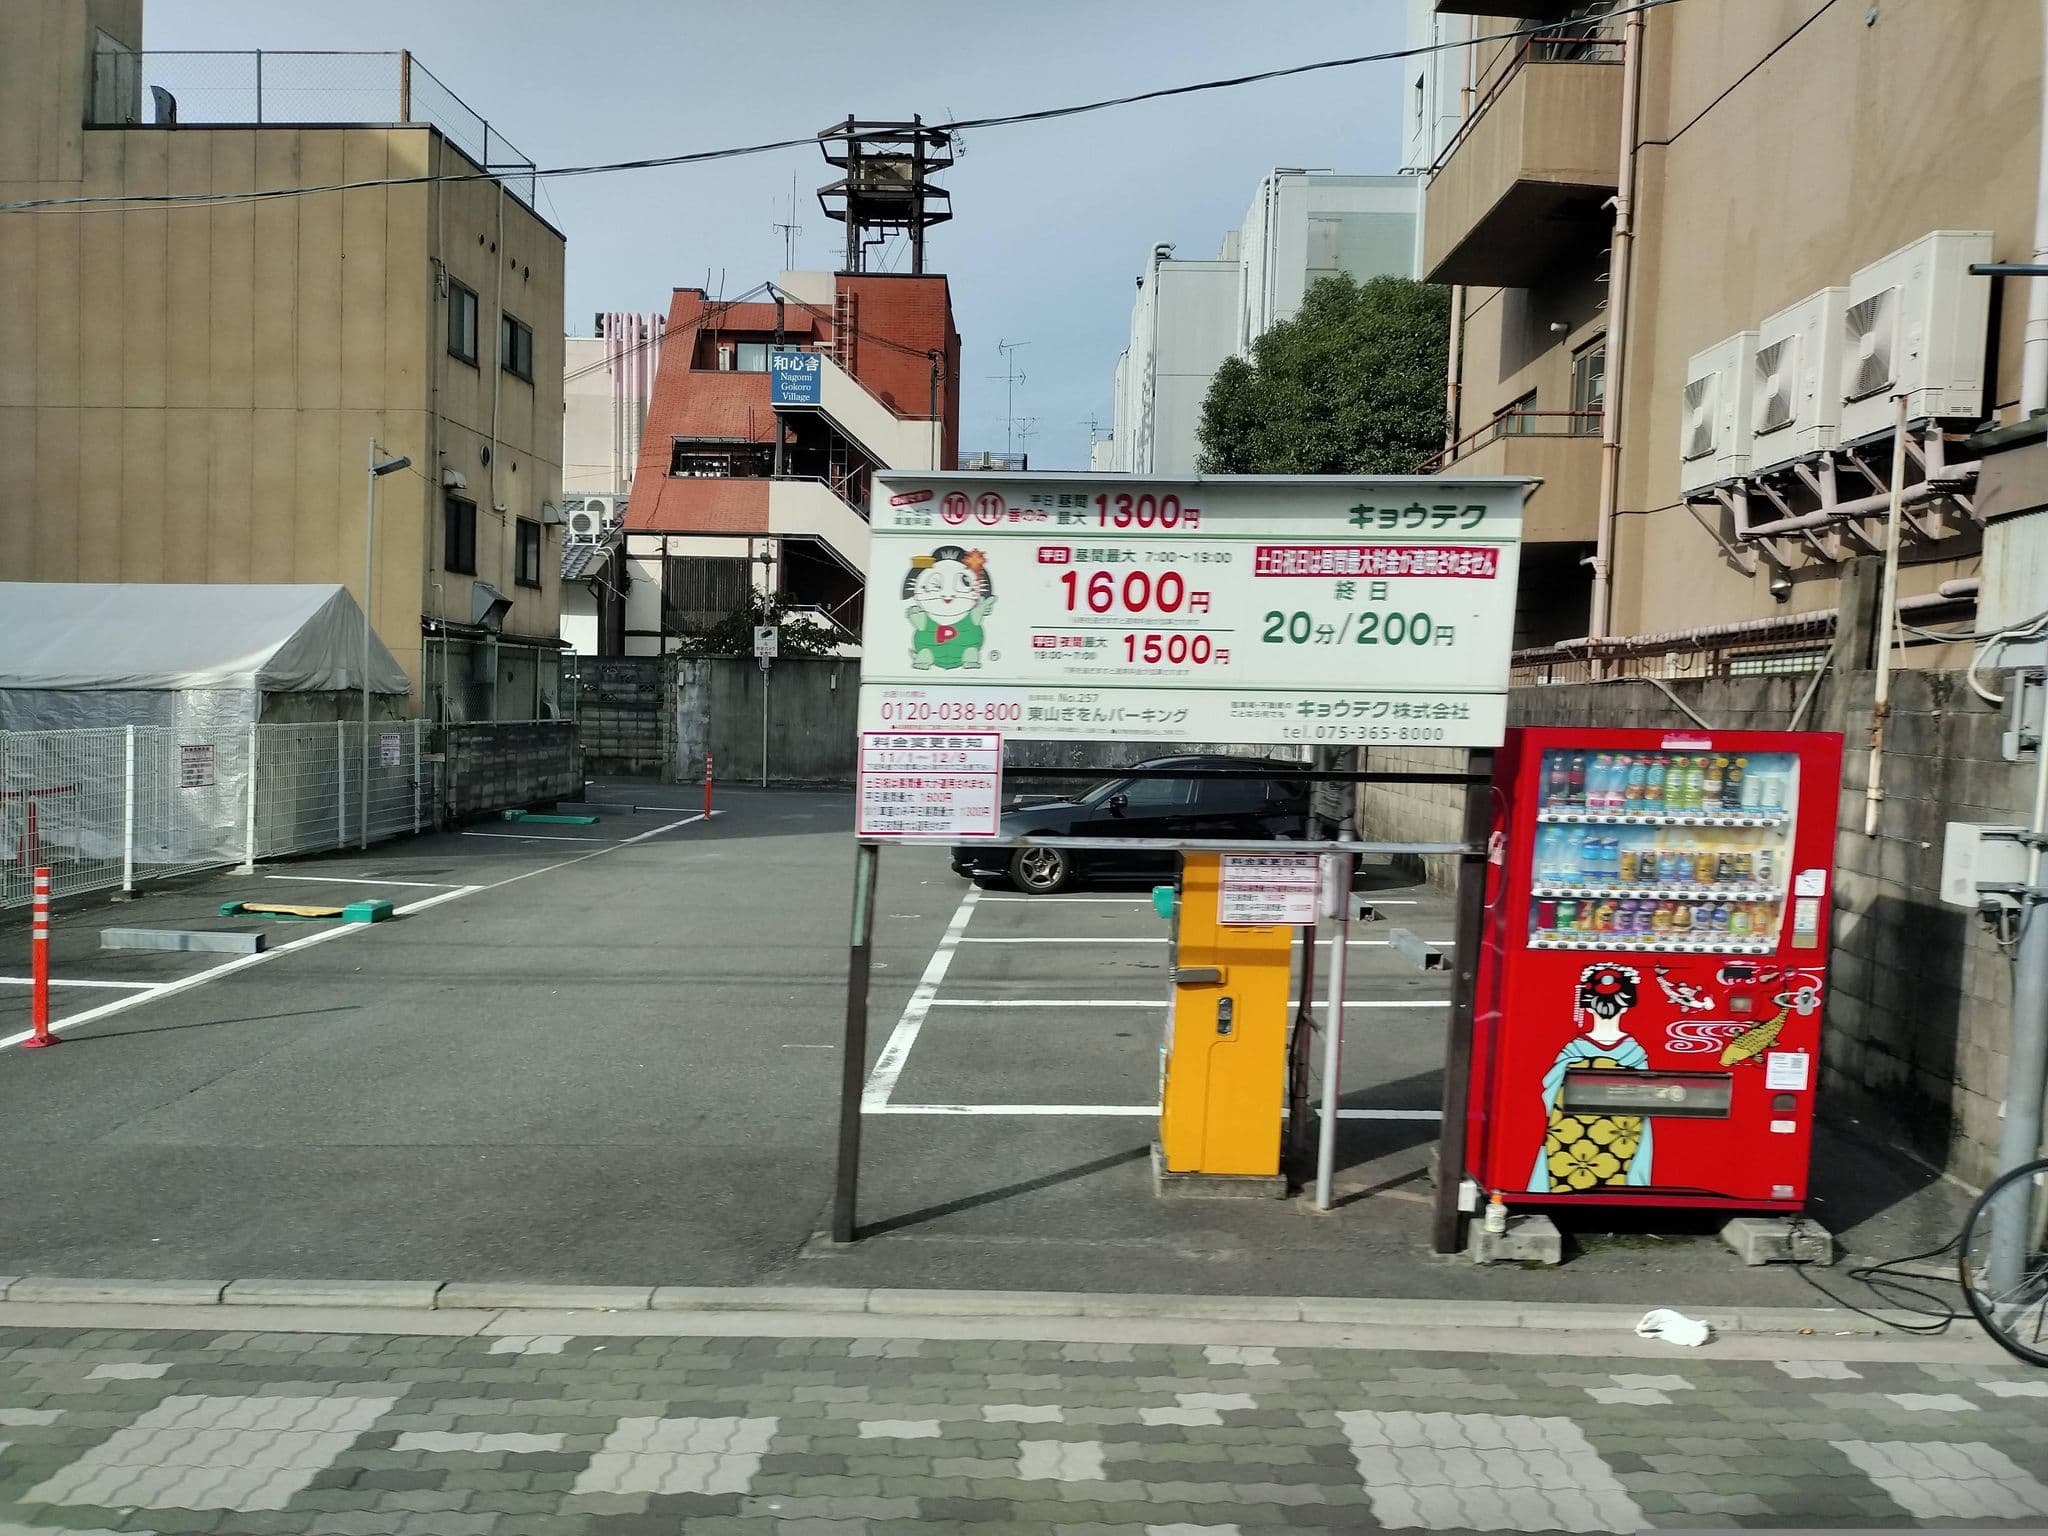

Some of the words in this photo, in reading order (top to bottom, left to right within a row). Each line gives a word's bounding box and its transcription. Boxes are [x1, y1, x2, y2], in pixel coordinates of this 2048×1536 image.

[780, 372, 812, 382] Nagomi
[781, 382, 811, 391] Gokoro
[783, 392, 810, 402] Village
[1095, 493, 1200, 529] 1300円
[1349, 503, 1487, 529] キョウテク
[1039, 548, 1069, 563] 平日
[1075, 549, 1136, 563] 昼間最大
[1061, 570, 1210, 614] 1600円
[936, 625, 958, 644] P
[1124, 634, 1230, 665] 1500円
[881, 702, 1021, 720] 0120-038-800
[1297, 700, 1470, 719] キョウテク株式会社
[872, 736, 983, 748] 料金変更告知
